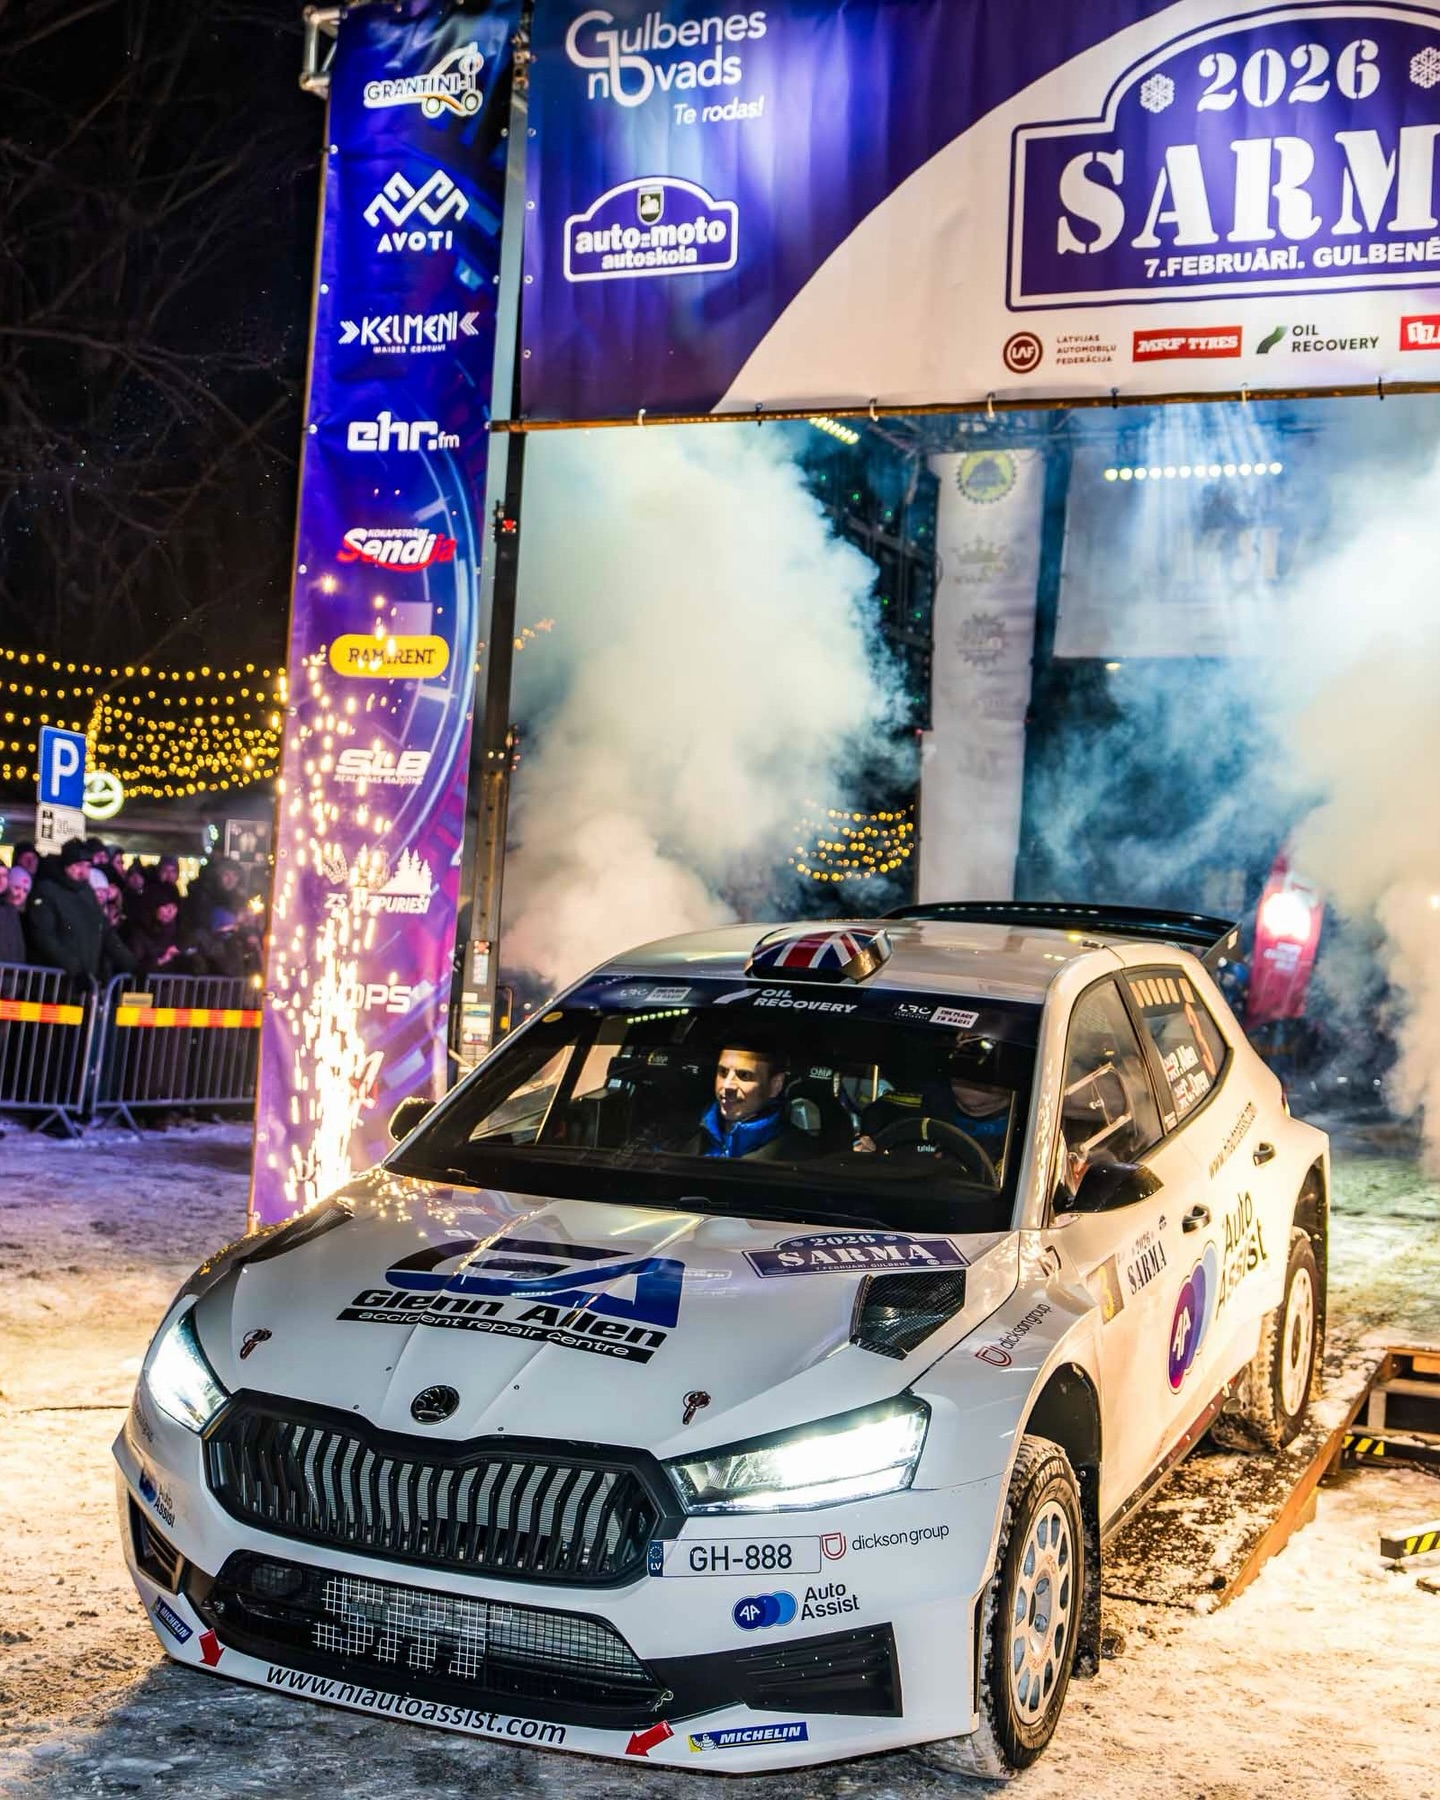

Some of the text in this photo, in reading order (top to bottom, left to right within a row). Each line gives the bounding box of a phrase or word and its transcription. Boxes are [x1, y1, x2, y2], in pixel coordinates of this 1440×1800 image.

[566, 10, 767, 68] Gulbenes
[588, 44, 743, 107] novads
[1197, 38, 1381, 112] 2026
[673, 94, 765, 125] Te rodas!
[377, 230, 453, 253] AVOTI
[601, 245, 698, 270] autoskola
[360, 311, 458, 346] KELMENI
[1056, 335, 1100, 343] LATVIJAS
[1291, 324, 1319, 337] OIL
[1011, 345, 1036, 360] LAF
[1137, 335, 1239, 353] MRF TYRES
[1291, 336, 1380, 353] RECOVERY
[347, 646, 436, 666] RAMRENT
[52, 737, 80, 797] P
[335, 749, 431, 777] SLB
[753, 997, 858, 1013] RECOVERY
[761, 988, 793, 998] OIL
[810, 1234, 877, 1247] 2026
[778, 1244, 937, 1267] SARMA
[1127, 1240, 1167, 1296] SARMA
[350, 1289, 668, 1349] Glenn Allen
[358, 1310, 630, 1357] accident repair centre
[650, 1562, 662, 1571] LV
[689, 1543, 793, 1572] GH-888
[803, 1582, 847, 1604] Auto
[800, 1594, 861, 1621] Assist
[159, 1608, 188, 1640] MICHELIN
[266, 1664, 567, 1745] www.niautoassist.com
[719, 1725, 801, 1744] MICHELIN
